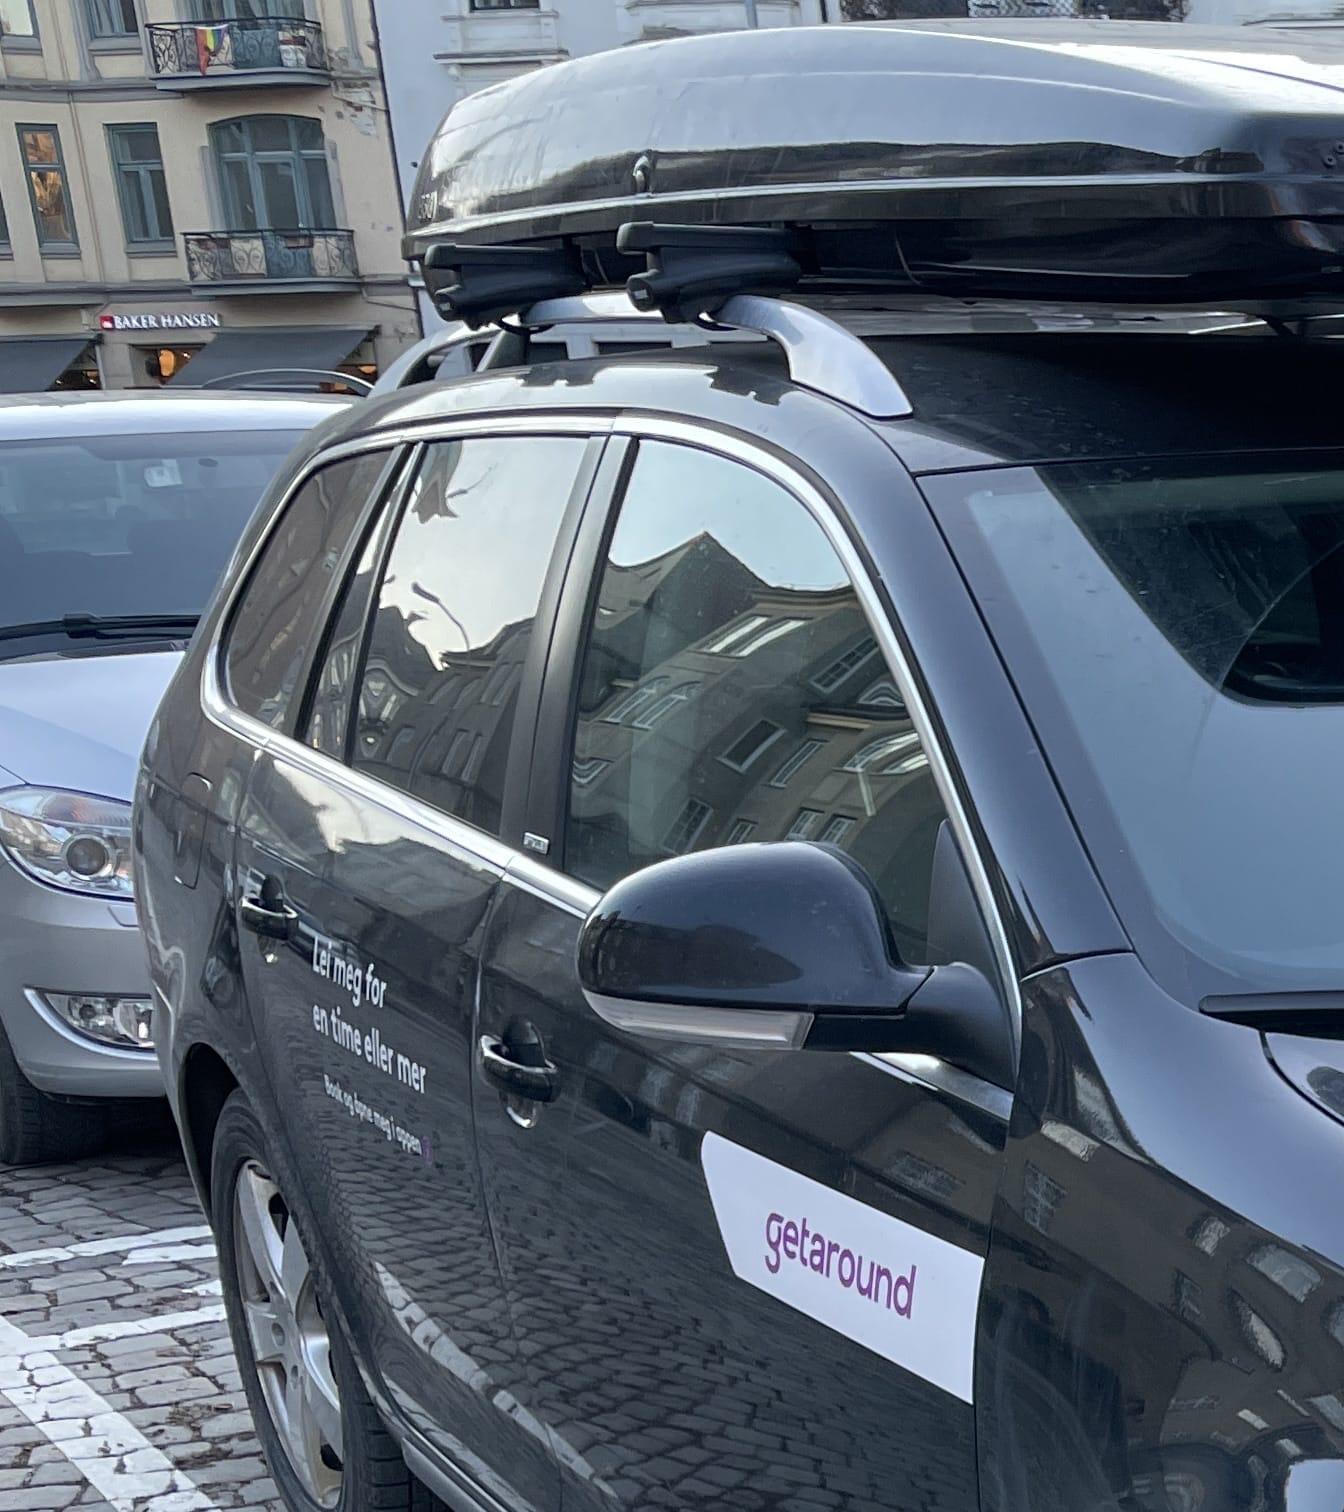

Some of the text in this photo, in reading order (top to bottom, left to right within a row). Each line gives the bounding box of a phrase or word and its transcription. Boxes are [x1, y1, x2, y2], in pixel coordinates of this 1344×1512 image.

[113, 312, 221, 329] BAKER HANSEN
[313, 936, 387, 1008] Lei meg for
[312, 1004, 427, 1094] en time eller mer
[764, 1212, 917, 1320] getaround
